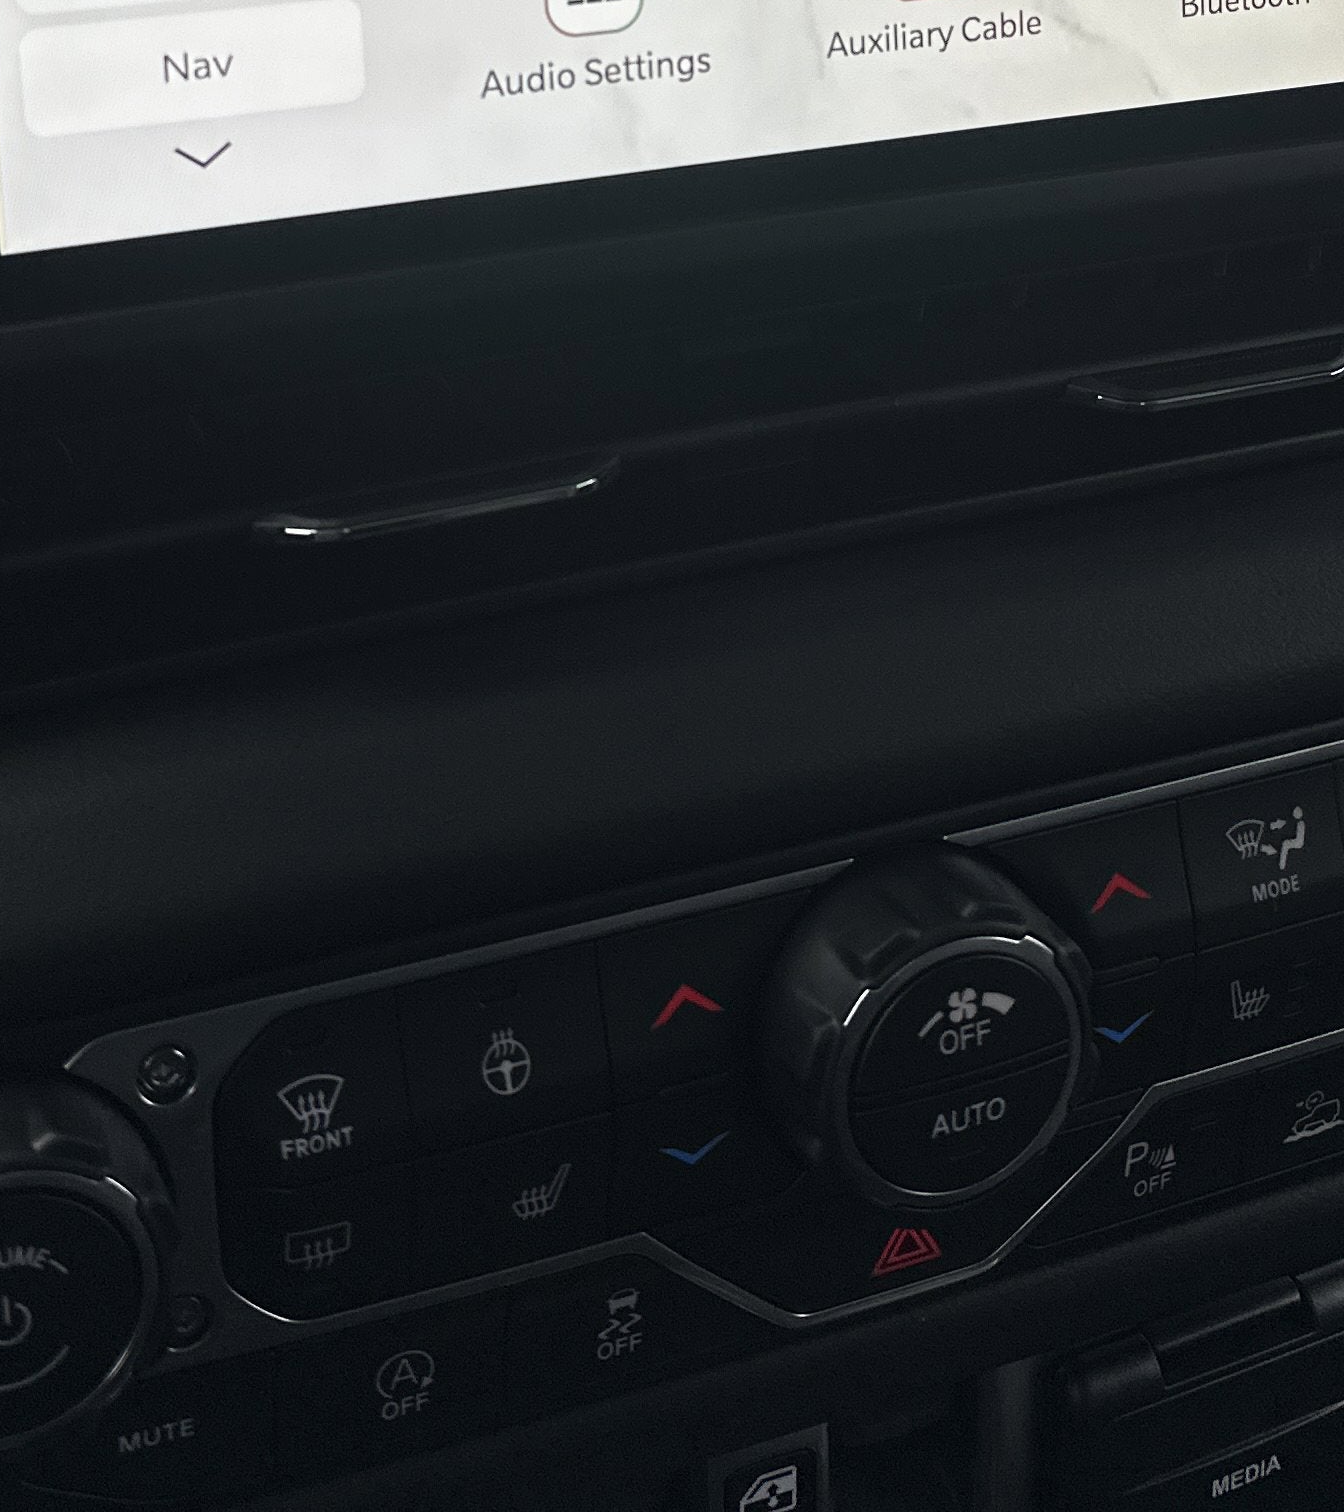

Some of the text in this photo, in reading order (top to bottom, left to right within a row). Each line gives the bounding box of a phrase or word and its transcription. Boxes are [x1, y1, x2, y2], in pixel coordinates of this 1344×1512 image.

[825, 8, 1044, 61] Auxiliary Cable
[162, 51, 235, 84] Nav
[479, 44, 713, 101] Audio Settings
[1251, 874, 1301, 903] MODE
[938, 1017, 992, 1056] OFF
[931, 1096, 1006, 1139] AUTO
[280, 1125, 354, 1160] FRONT
[1133, 1170, 1172, 1197] OFF
[596, 1332, 643, 1360] OFF
[381, 1393, 430, 1420] OFF
[117, 1418, 196, 1453] MUTE
[1211, 1454, 1282, 1499] MEDIA
